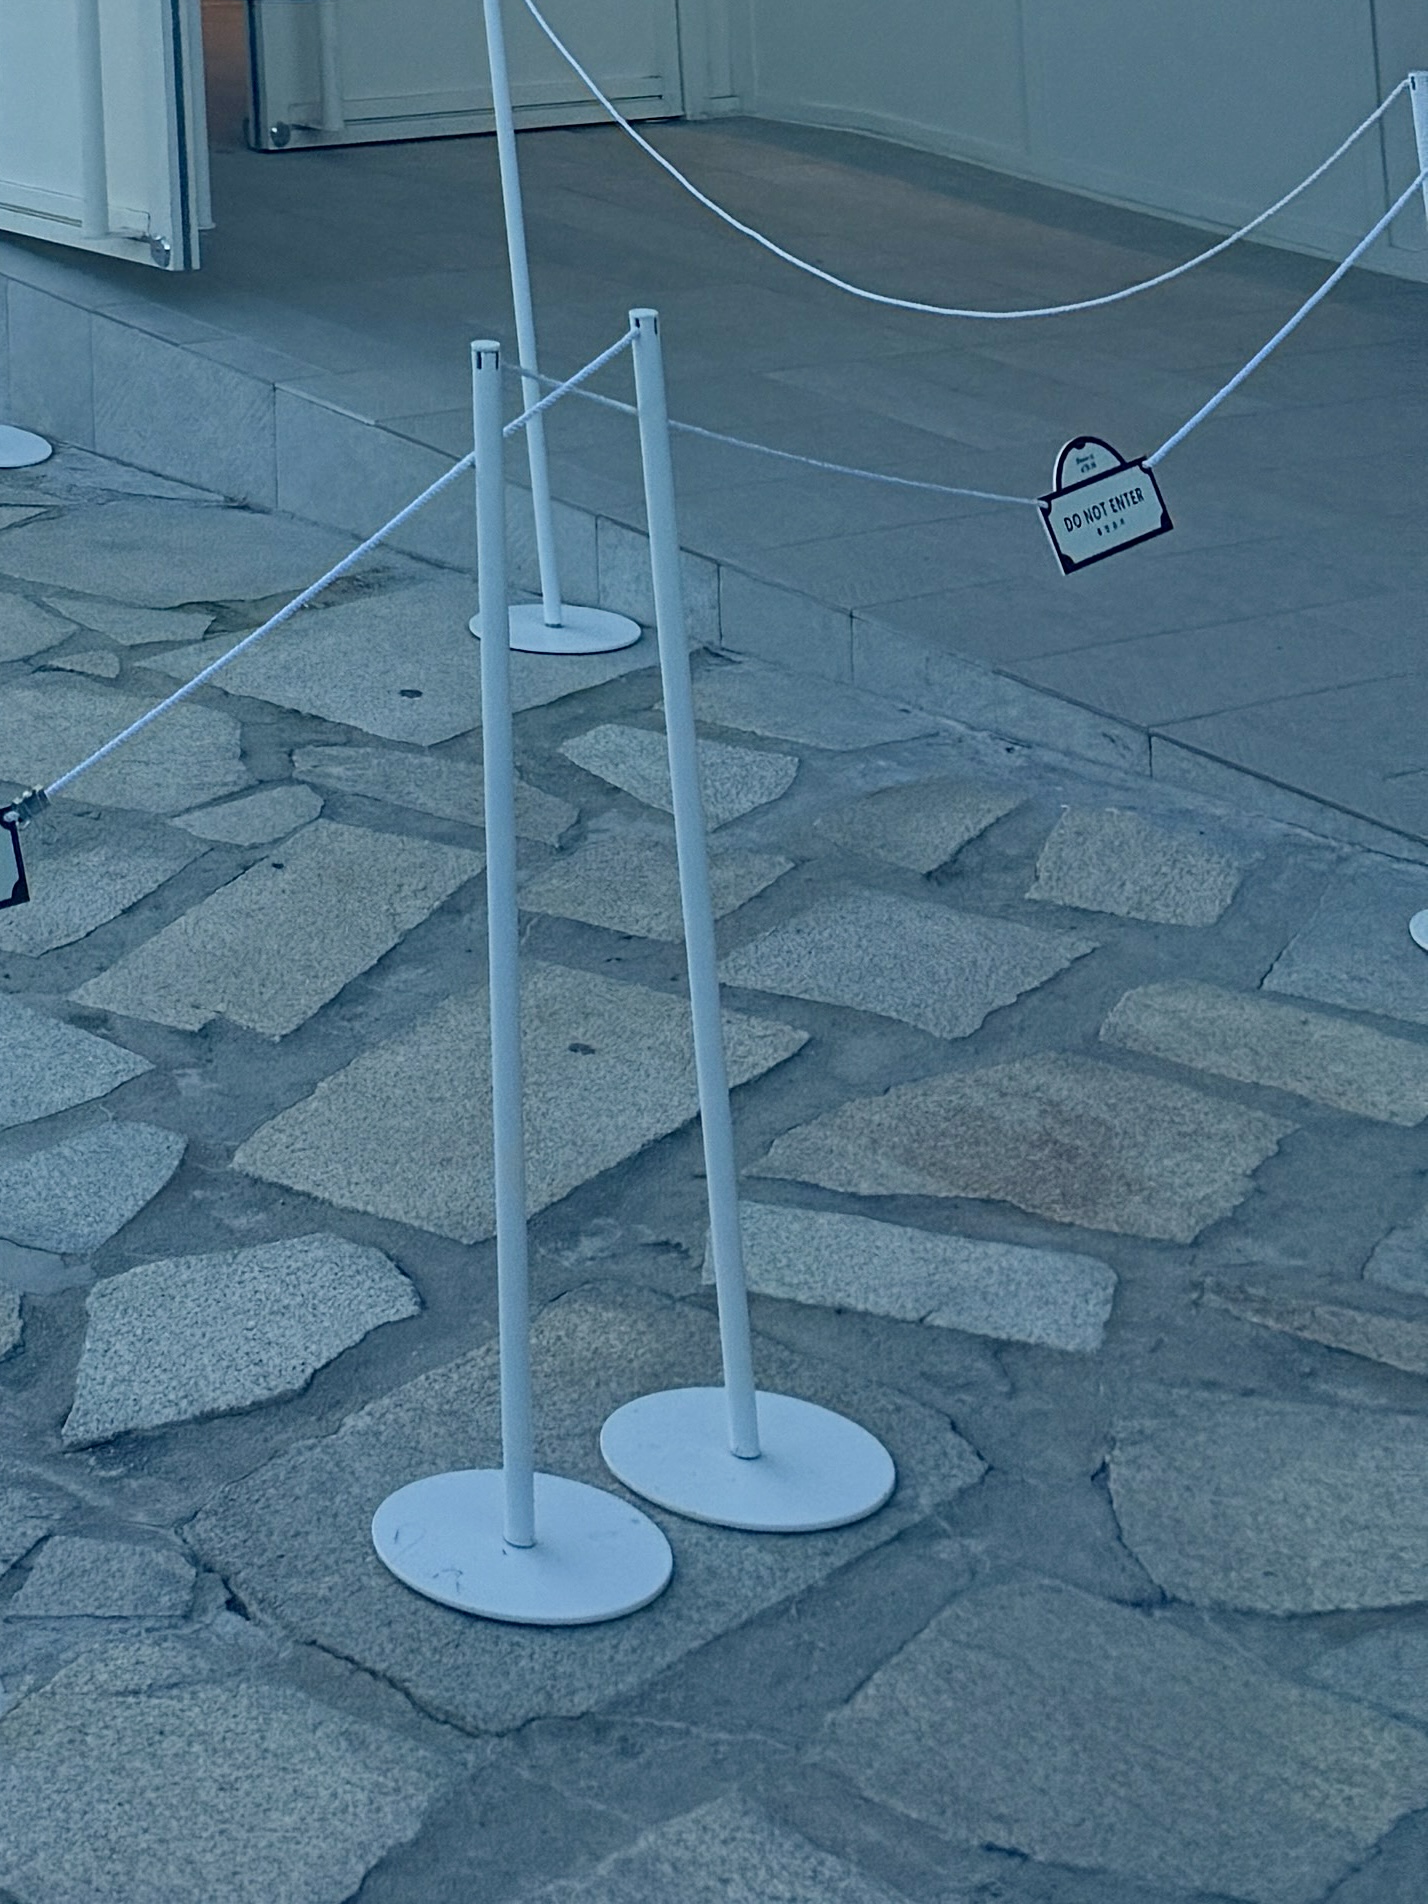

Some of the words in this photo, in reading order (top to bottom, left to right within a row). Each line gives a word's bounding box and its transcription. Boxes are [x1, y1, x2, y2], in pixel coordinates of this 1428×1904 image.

[1064, 513, 1082, 532] DO
[1084, 502, 1107, 524] NOT
[1109, 488, 1144, 513] ENTER
